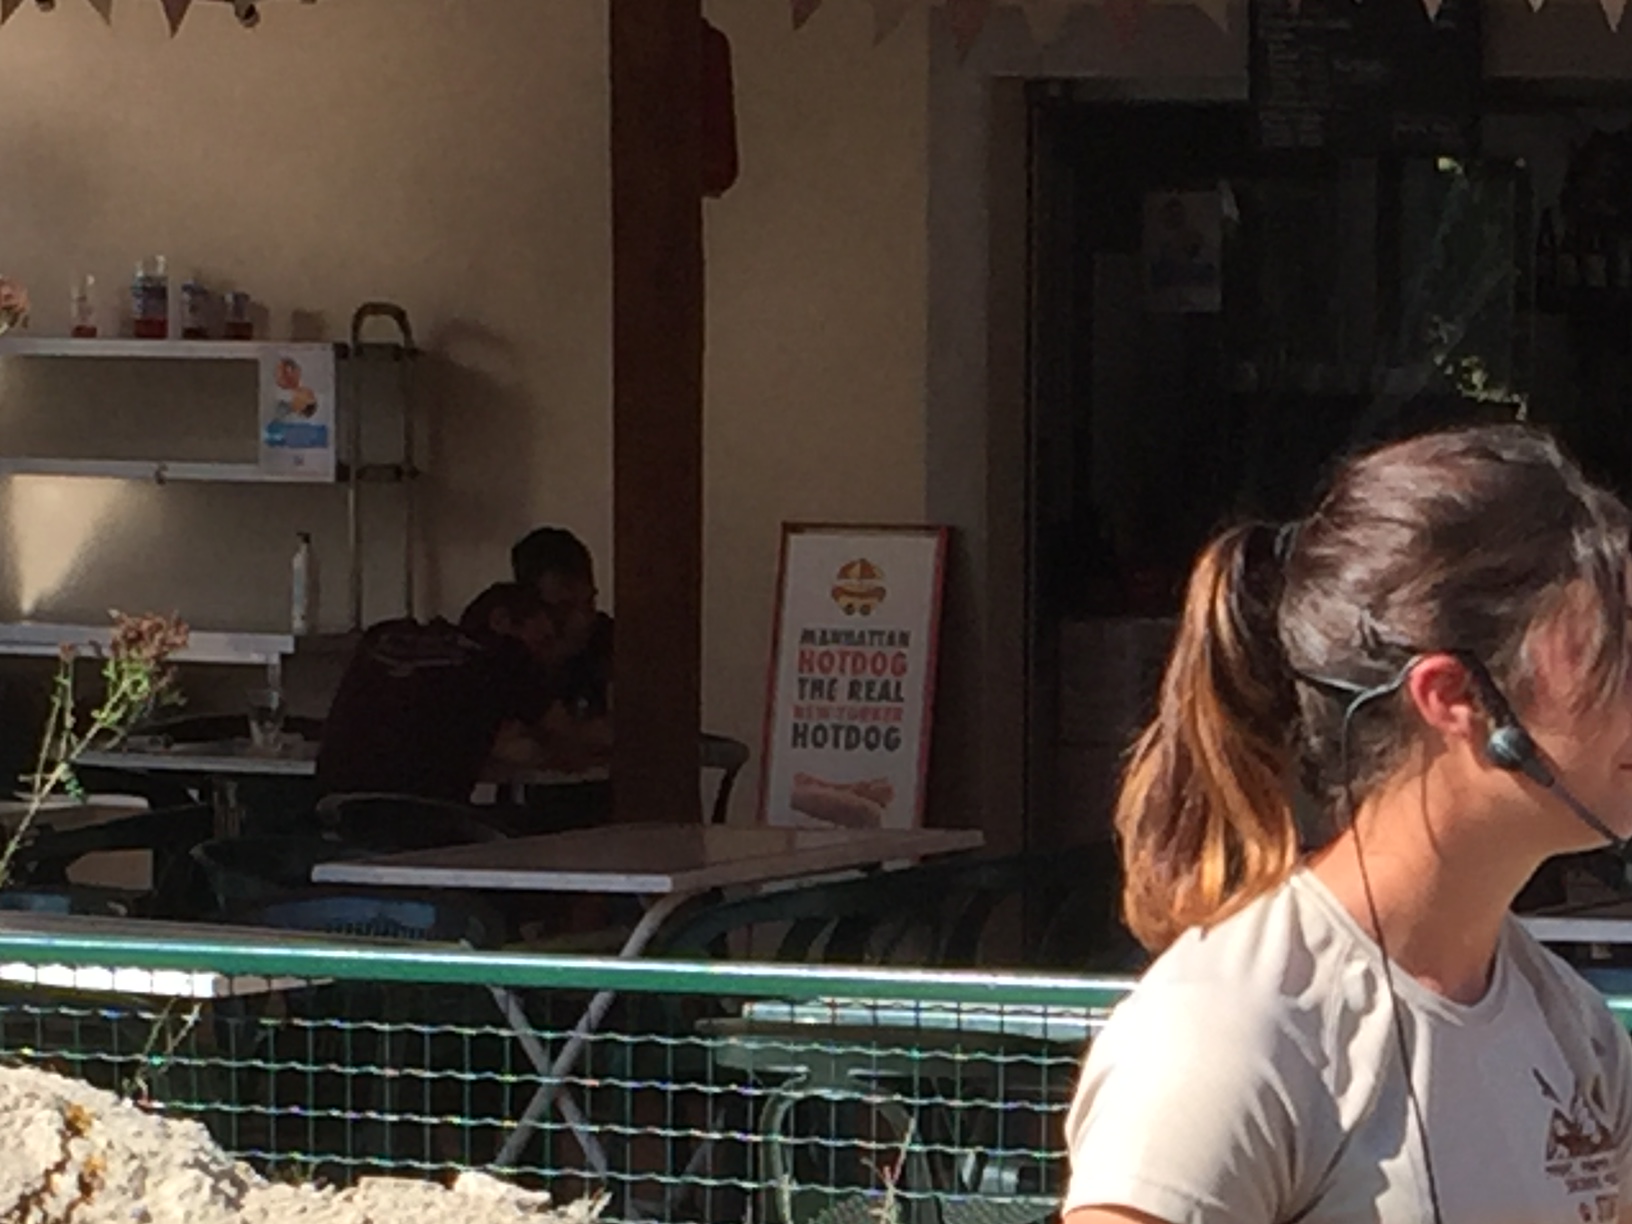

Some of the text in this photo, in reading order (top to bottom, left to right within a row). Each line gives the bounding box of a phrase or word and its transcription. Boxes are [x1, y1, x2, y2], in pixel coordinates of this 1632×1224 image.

[799, 629, 911, 648] MANHATTAN
[797, 648, 909, 678] HOTDOG
[797, 677, 905, 703] THE REAL
[791, 721, 903, 753] HOTDOG
